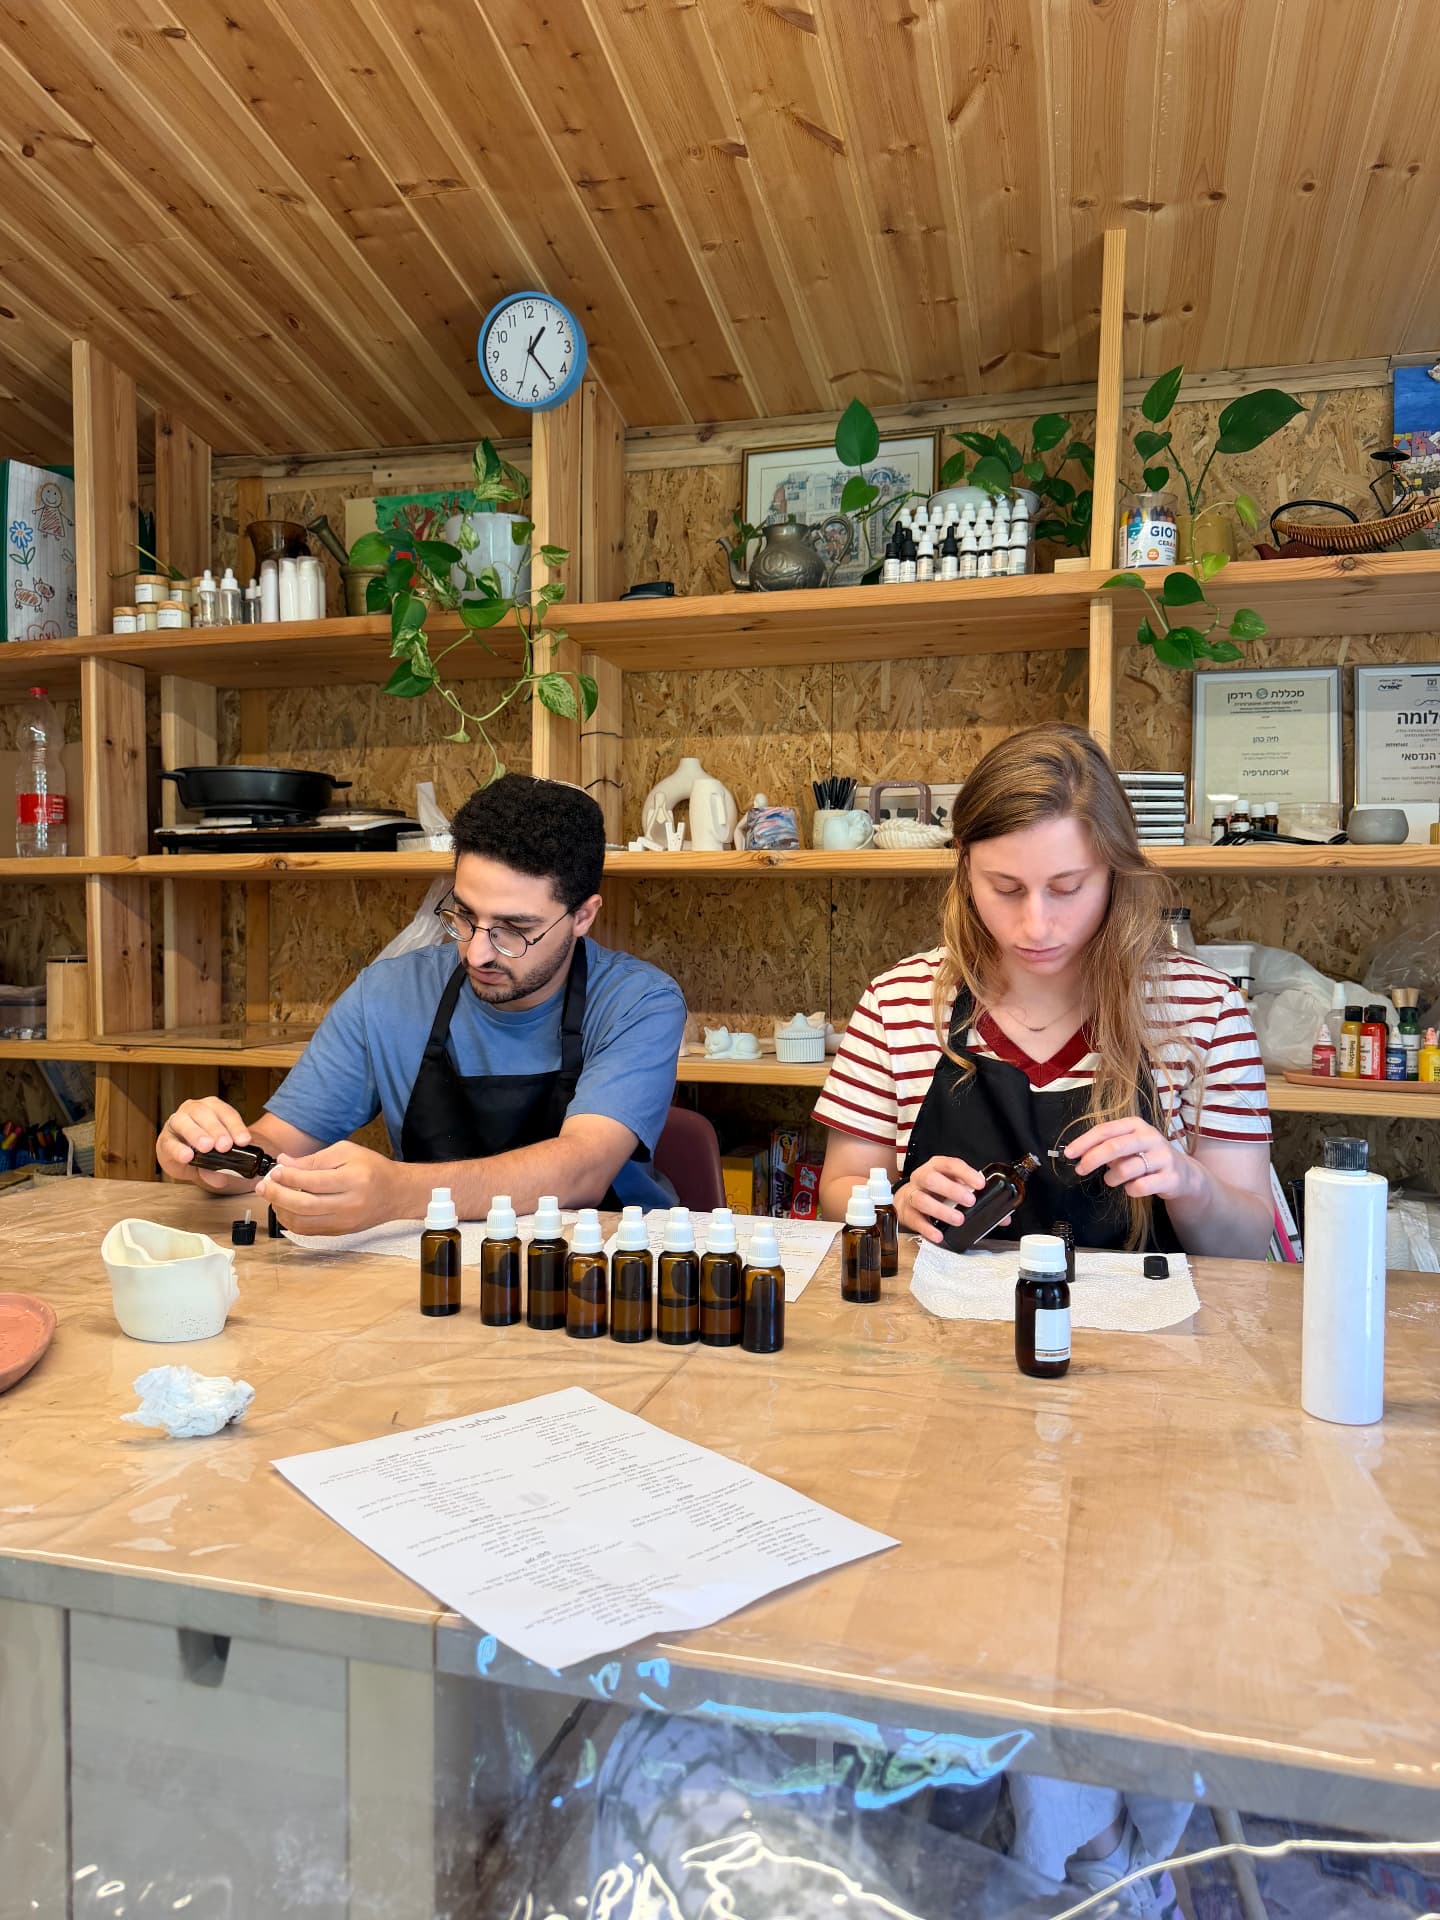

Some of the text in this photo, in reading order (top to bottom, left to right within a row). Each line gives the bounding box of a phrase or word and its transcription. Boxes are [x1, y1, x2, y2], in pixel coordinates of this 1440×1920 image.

[523, 305, 534, 320] 12
[544, 308, 549, 322] 1
[507, 314, 517, 328] 11
[556, 320, 564, 334] 2
[496, 330, 508, 344] 10
[564, 340, 572, 354] 3
[492, 350, 500, 363] 9
[500, 368, 508, 382] 8
[559, 361, 568, 375] 4
[516, 381, 524, 395] 7
[531, 383, 539, 398] 6
[548, 376, 556, 391] 5
[1227, 691, 1252, 704] רידמן
[1271, 689, 1305, 698] מכללת
[1397, 710, 1440, 725] לומה
[1401, 752, 1436, 761] הנדסאי
[1242, 768, 1290, 777] ארומתרפיה
